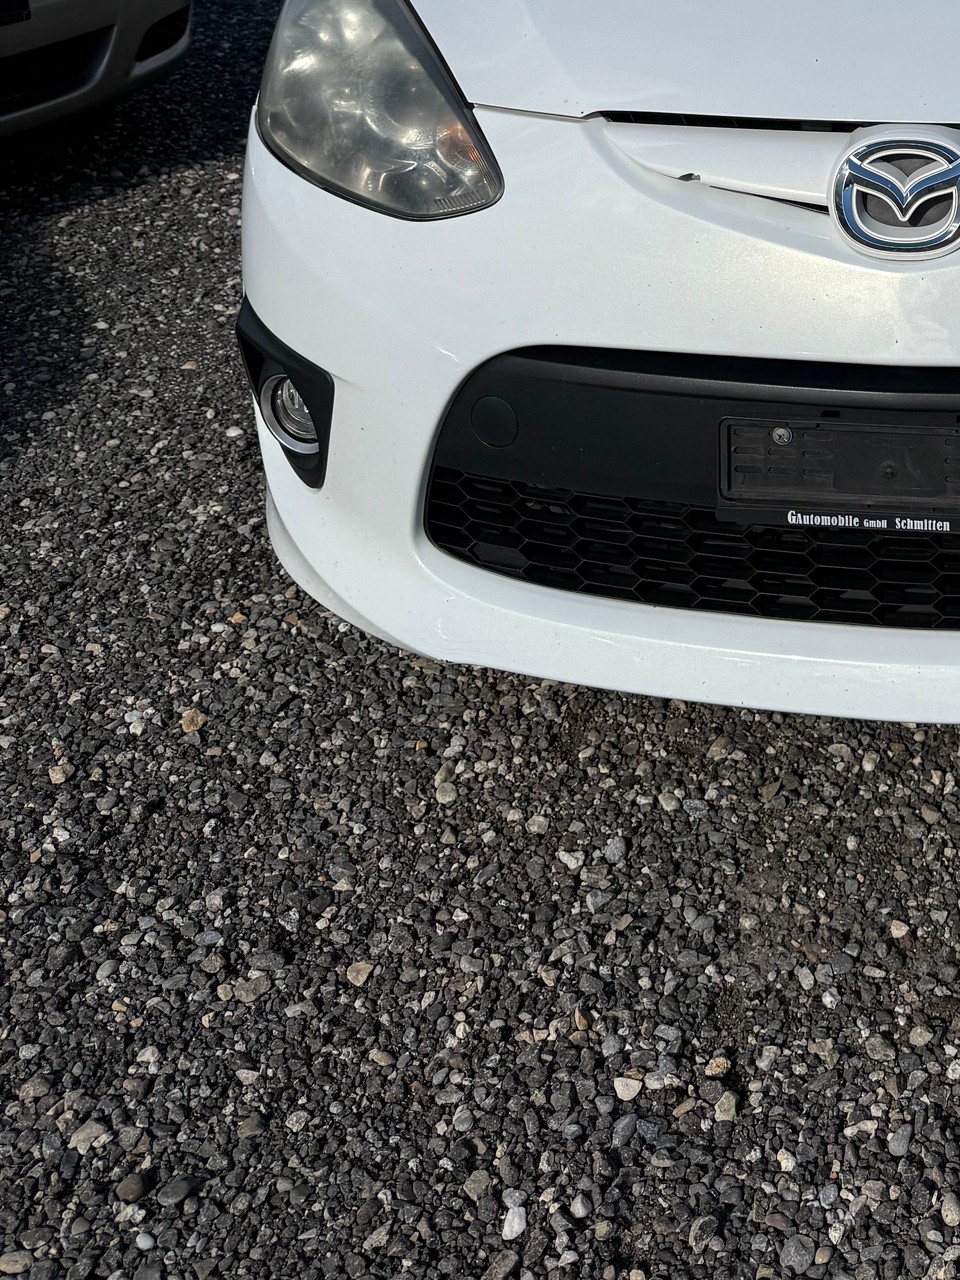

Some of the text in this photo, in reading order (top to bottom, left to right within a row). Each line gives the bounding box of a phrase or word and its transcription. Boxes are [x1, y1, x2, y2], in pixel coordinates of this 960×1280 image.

[787, 510, 951, 532] GAutomobile GmbH Schmitten
